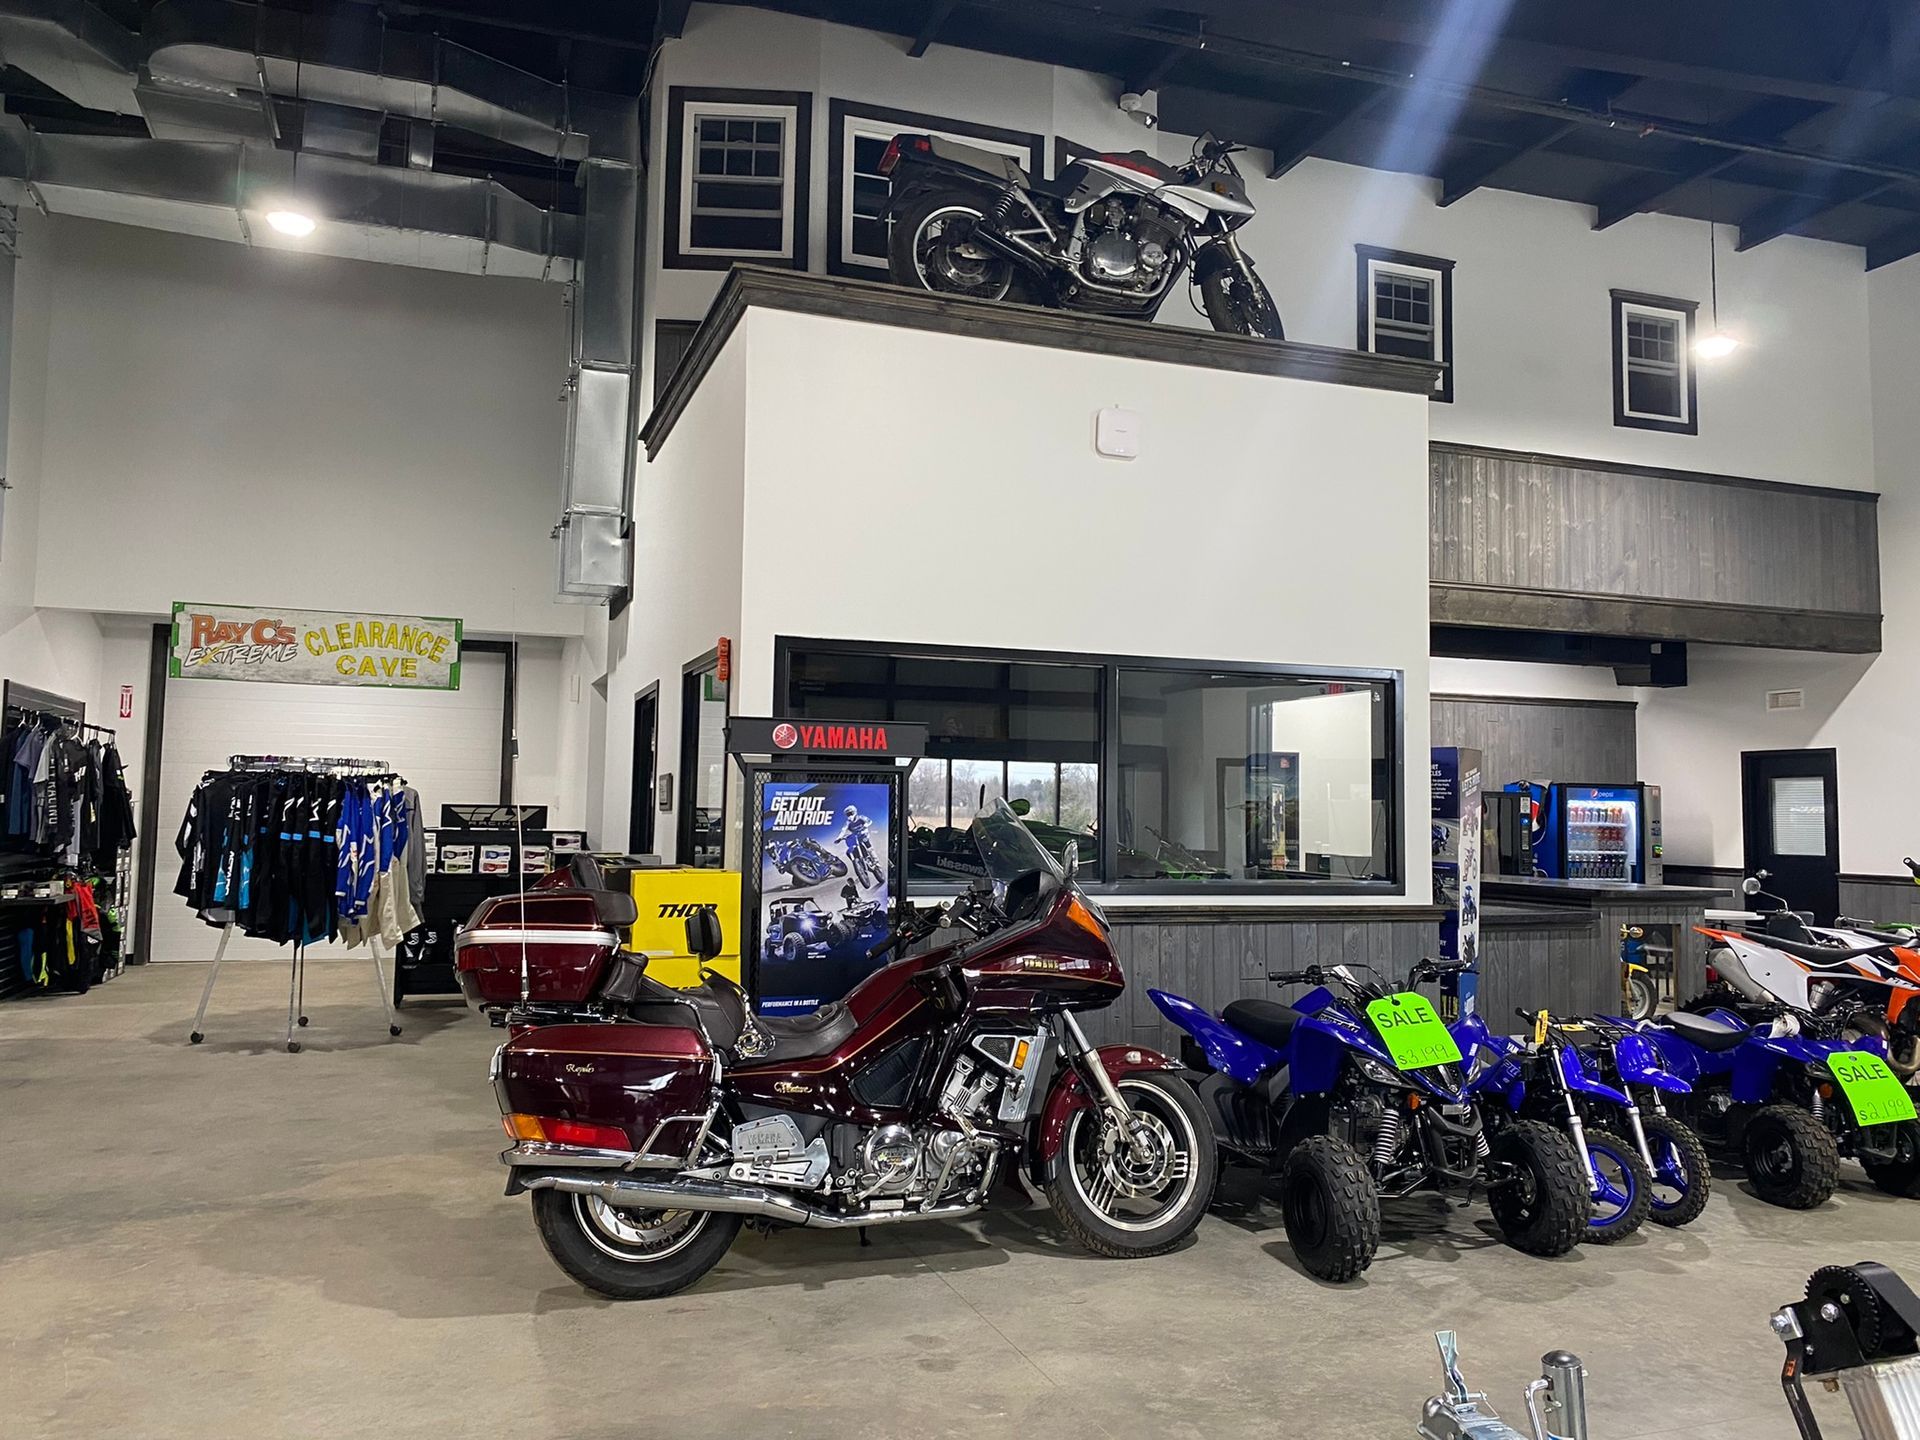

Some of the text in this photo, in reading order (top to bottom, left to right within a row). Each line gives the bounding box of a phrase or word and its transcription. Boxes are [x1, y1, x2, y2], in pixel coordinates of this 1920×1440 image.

[303, 620, 451, 664] CLEARANCE
[184, 642, 298, 667] EXTREME
[336, 655, 418, 679] CAVE
[799, 725, 888, 750] YAMAHA
[770, 796, 826, 811] GET OUT
[773, 810, 835, 826] AND RIDE
[1377, 1007, 1433, 1029] SALE
[1838, 1063, 1890, 1084] SALE
